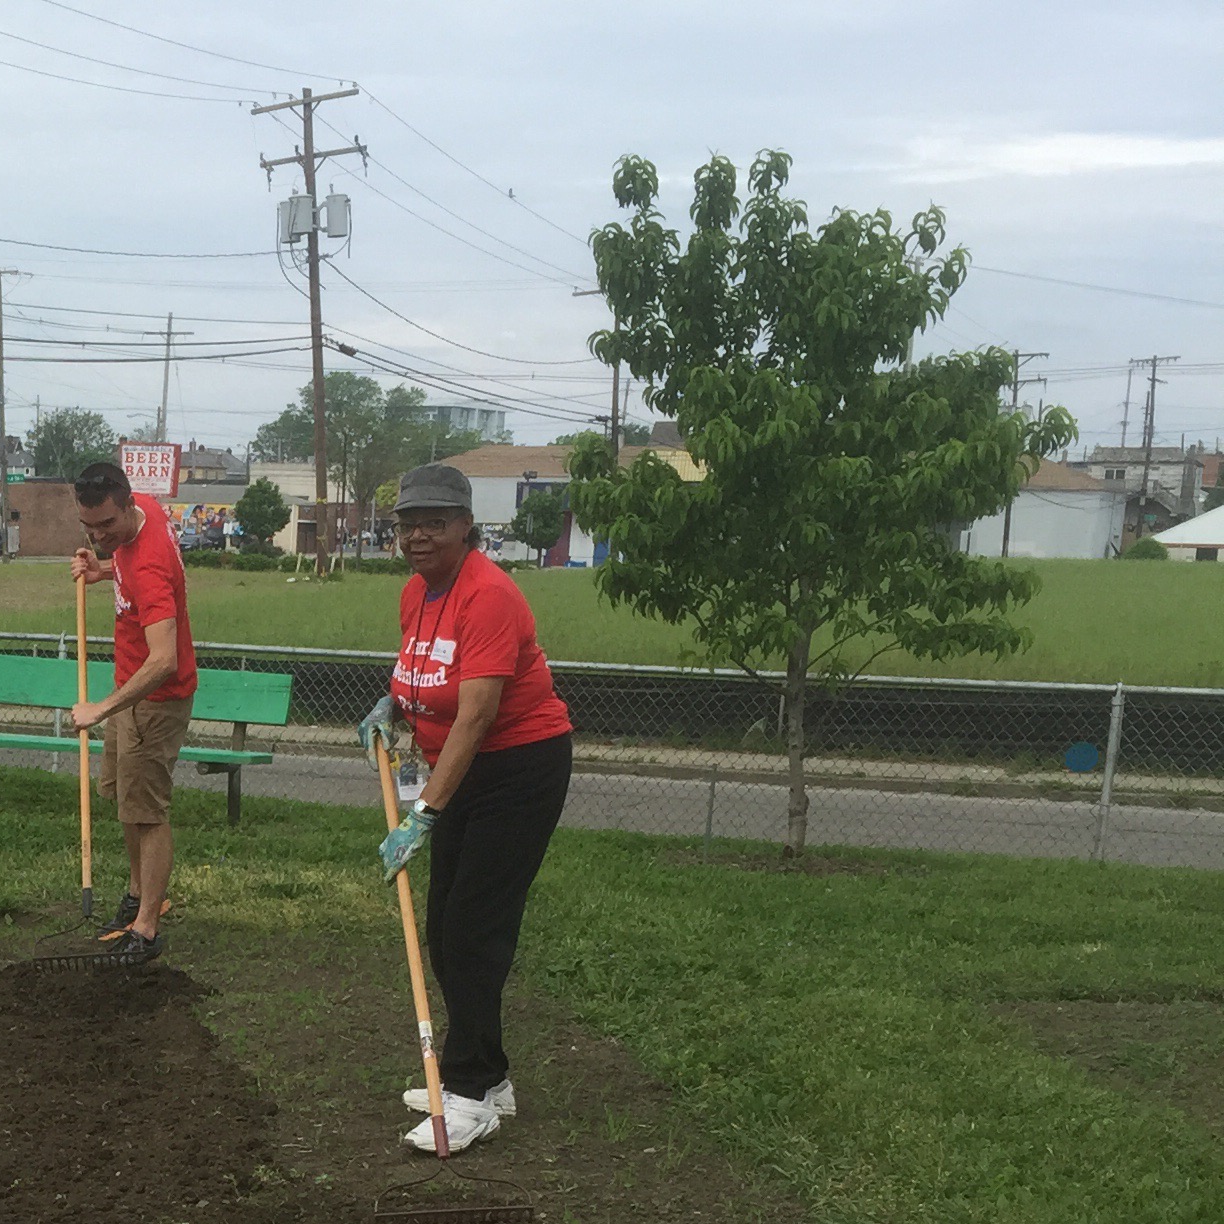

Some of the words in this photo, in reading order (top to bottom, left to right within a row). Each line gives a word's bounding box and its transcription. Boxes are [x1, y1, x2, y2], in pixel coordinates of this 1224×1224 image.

[125, 452, 171, 464] BEER
[125, 465, 170, 477] BARN
[405, 636, 416, 654] I
